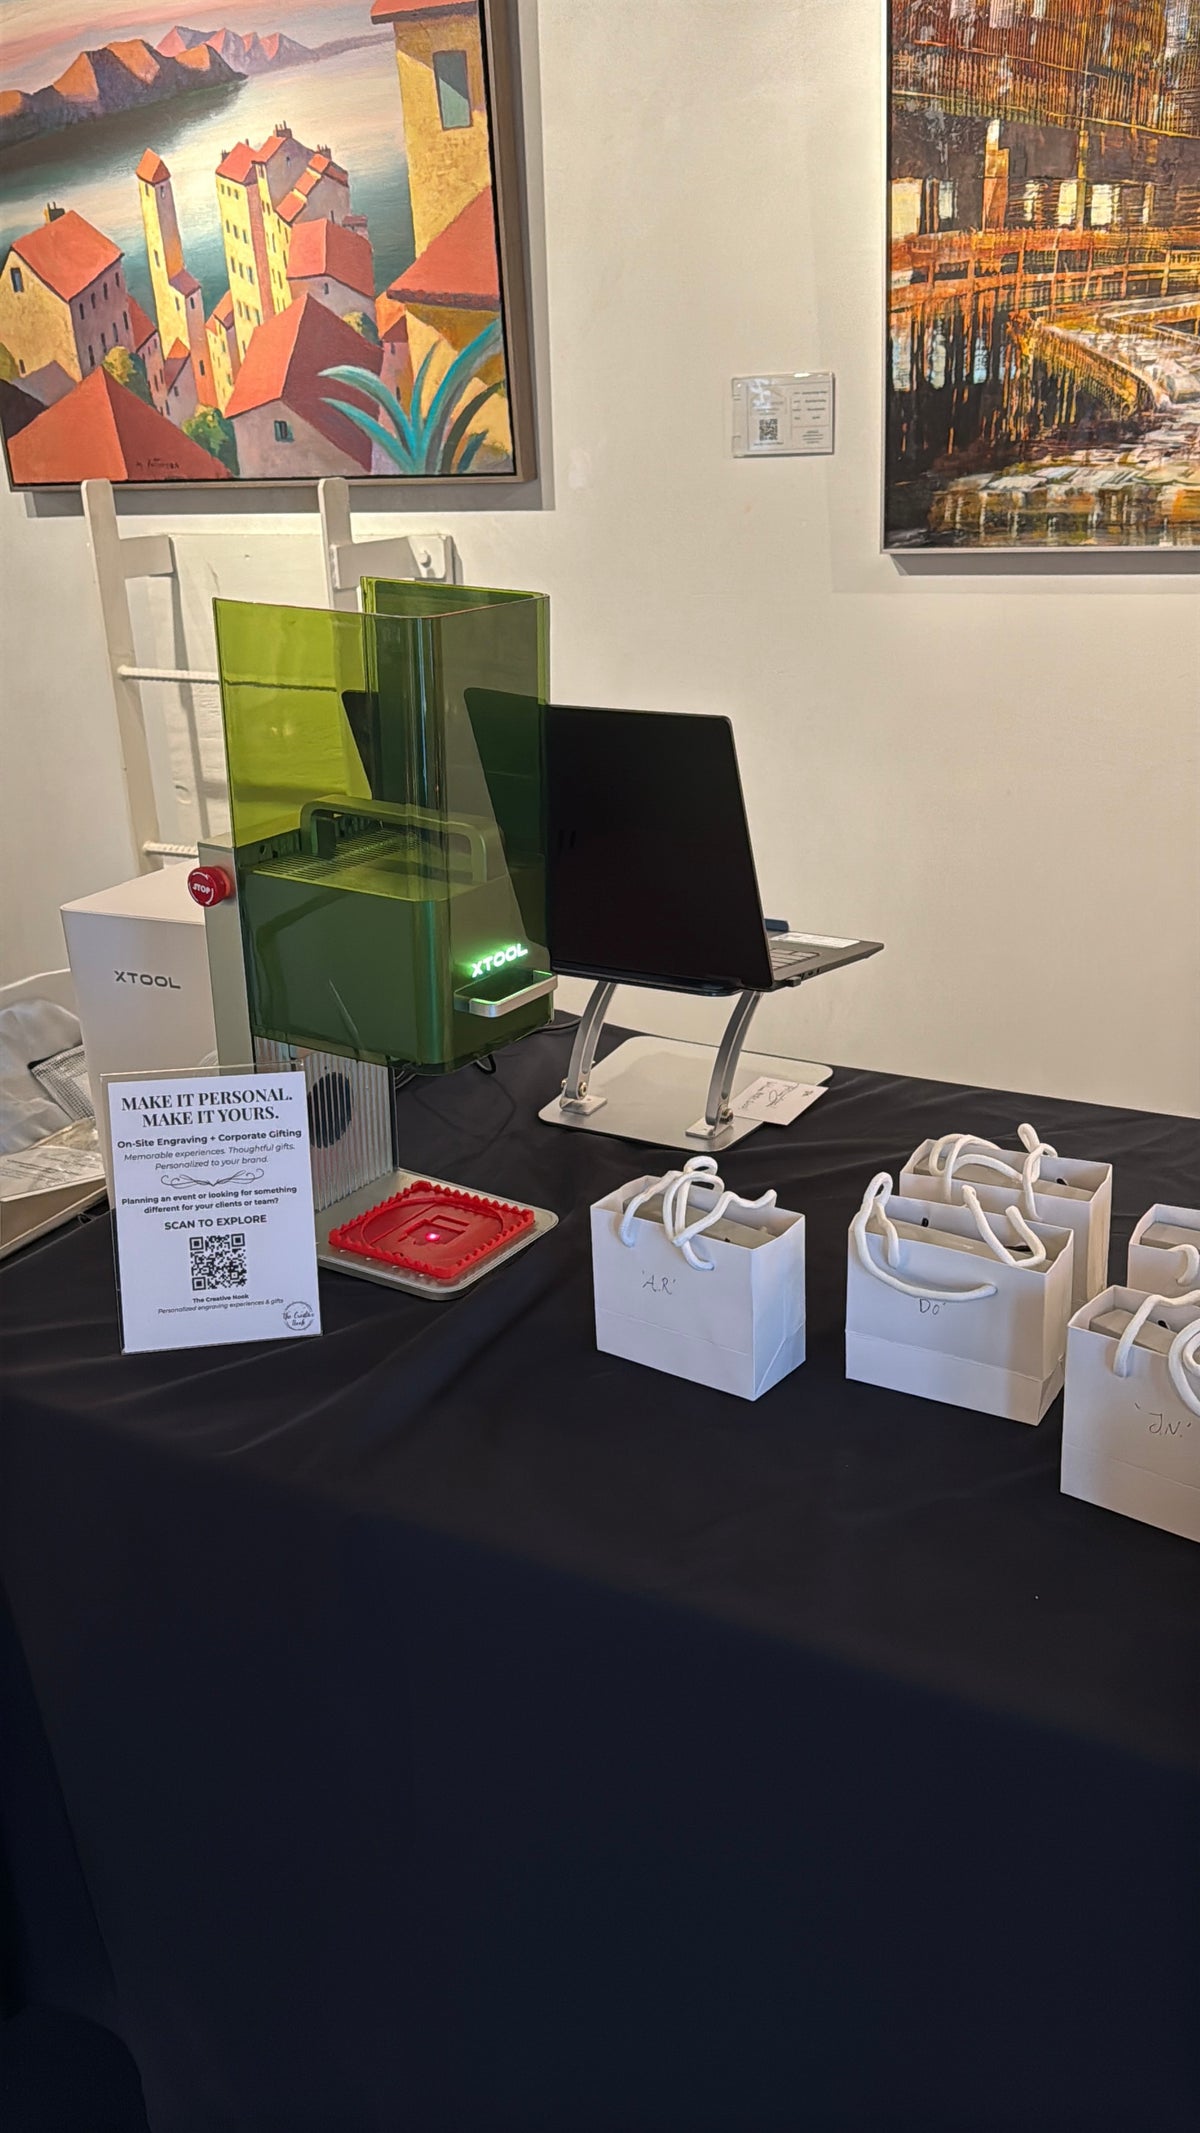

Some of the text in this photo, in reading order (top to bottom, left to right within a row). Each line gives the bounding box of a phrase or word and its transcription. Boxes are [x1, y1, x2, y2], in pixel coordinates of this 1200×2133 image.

[192, 883, 211, 894] STOP
[471, 943, 528, 978] XTOOL
[114, 970, 181, 989] XTOOL
[121, 1088, 293, 1111] MAKE IT PERSONAL.
[142, 1106, 279, 1127] MAKE IT YOURS.
[117, 1139, 154, 1148] On-Site
[158, 1135, 207, 1147] Engraving
[218, 1131, 267, 1143] Corporate
[269, 1129, 301, 1139] Gifting
[124, 1142, 295, 1161] Memorable experiences. Thoughtful gifts.
[155, 1160, 209, 1170] Personalized
[221, 1158, 240, 1167] your
[242, 1156, 268, 1164] brand.
[122, 1196, 159, 1206] Planning
[173, 1193, 196, 1201] event
[208, 1190, 239, 1200] looking
[254, 1186, 297, 1195] something
[144, 1204, 179, 1214] different
[182, 1203, 193, 1211] for
[195, 1203, 213, 1212] your
[215, 1200, 242, 1208] clients
[255, 1197, 279, 1205] team?
[164, 1215, 267, 1230] SCAN TO EXPLORE
[206, 1295, 231, 1303] Creative
[158, 1306, 196, 1314] Personalized
